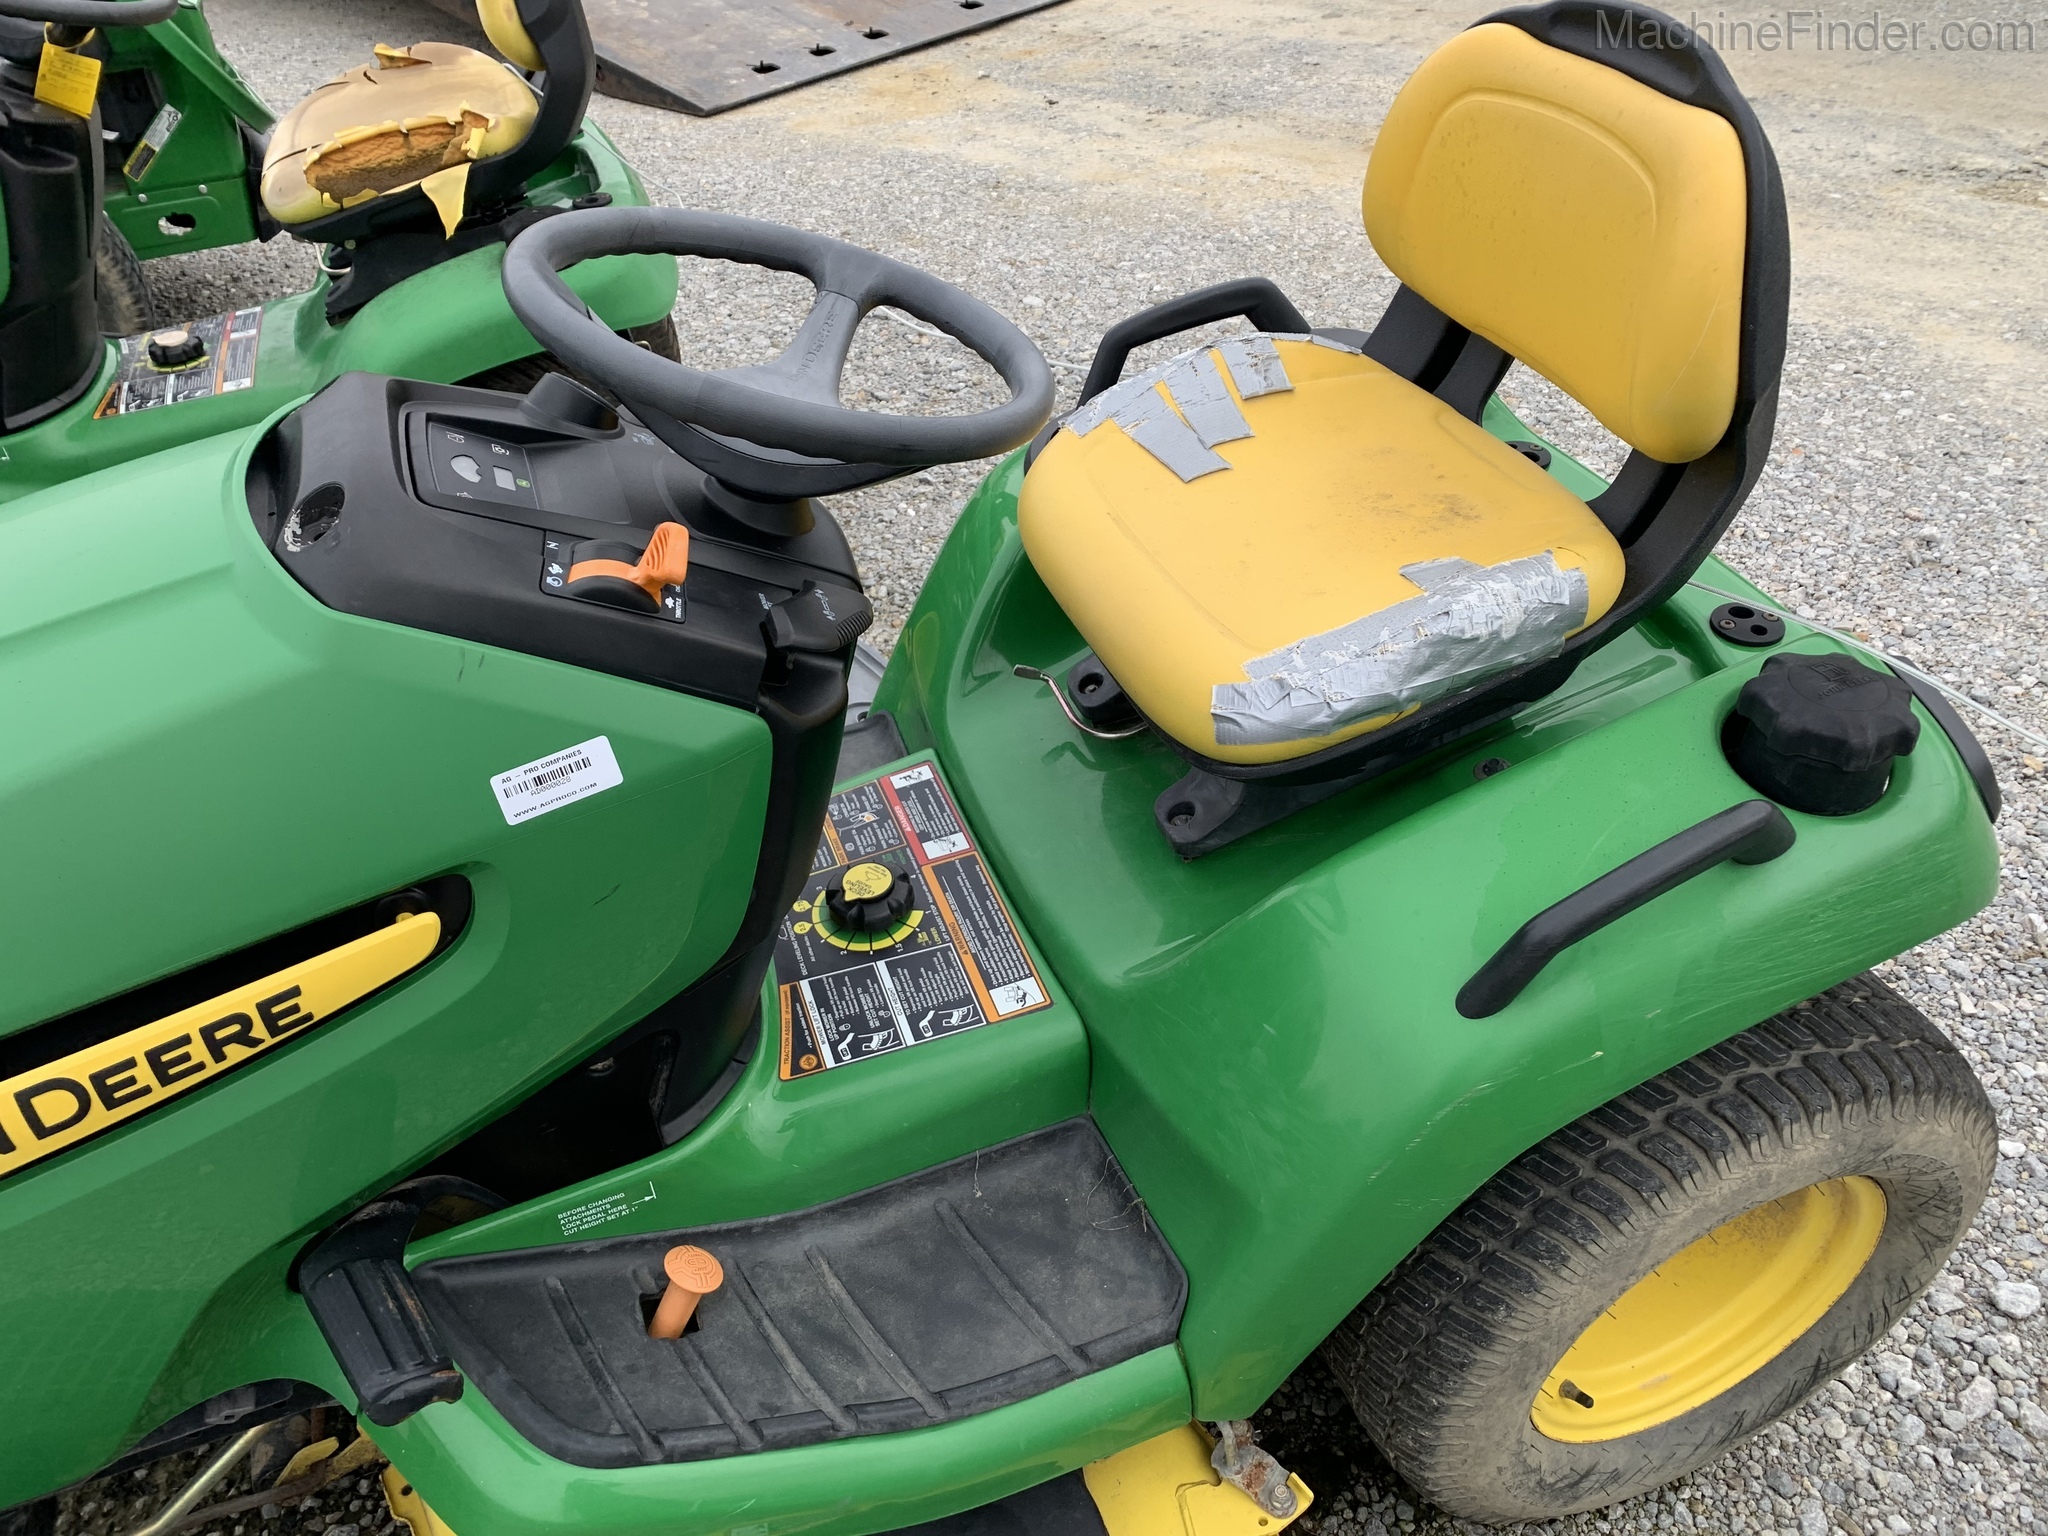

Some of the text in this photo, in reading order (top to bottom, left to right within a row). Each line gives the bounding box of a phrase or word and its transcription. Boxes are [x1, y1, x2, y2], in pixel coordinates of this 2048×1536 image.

[501, 776, 512, 784] AG
[523, 766, 539, 776] PRO
[540, 749, 582, 769] COMPANIES
[894, 804, 909, 827] DANGER
[832, 837, 846, 863] PARK BRAKE
[845, 879, 874, 895] LEVELING
[847, 886, 865, 896] DECK
[930, 903, 938, 914] STOP
[930, 926, 942, 944] LOWER
[934, 914, 946, 932] ADJUST
[942, 931, 950, 941] LIFT
[948, 921, 965, 950] WARNING
[786, 920, 808, 975] DECK LEVELING POSITION
[895, 942, 904, 952] 1.5
[887, 986, 902, 1016] CUT HEIGHT
[808, 999, 826, 1045] MOWER LIFT LOCK
[13, 984, 315, 1141] DEERE
[557, 1192, 626, 1220] BEFORE CHANGING
[560, 1203, 611, 1225] ATTACHMENTS
[561, 1203, 628, 1231] LOCK PEDAL HERE
[563, 1227, 579, 1236] CUT
[579, 1218, 605, 1231] HEIGHT
[606, 1212, 620, 1221] SET
[621, 1208, 630, 1216] AT
